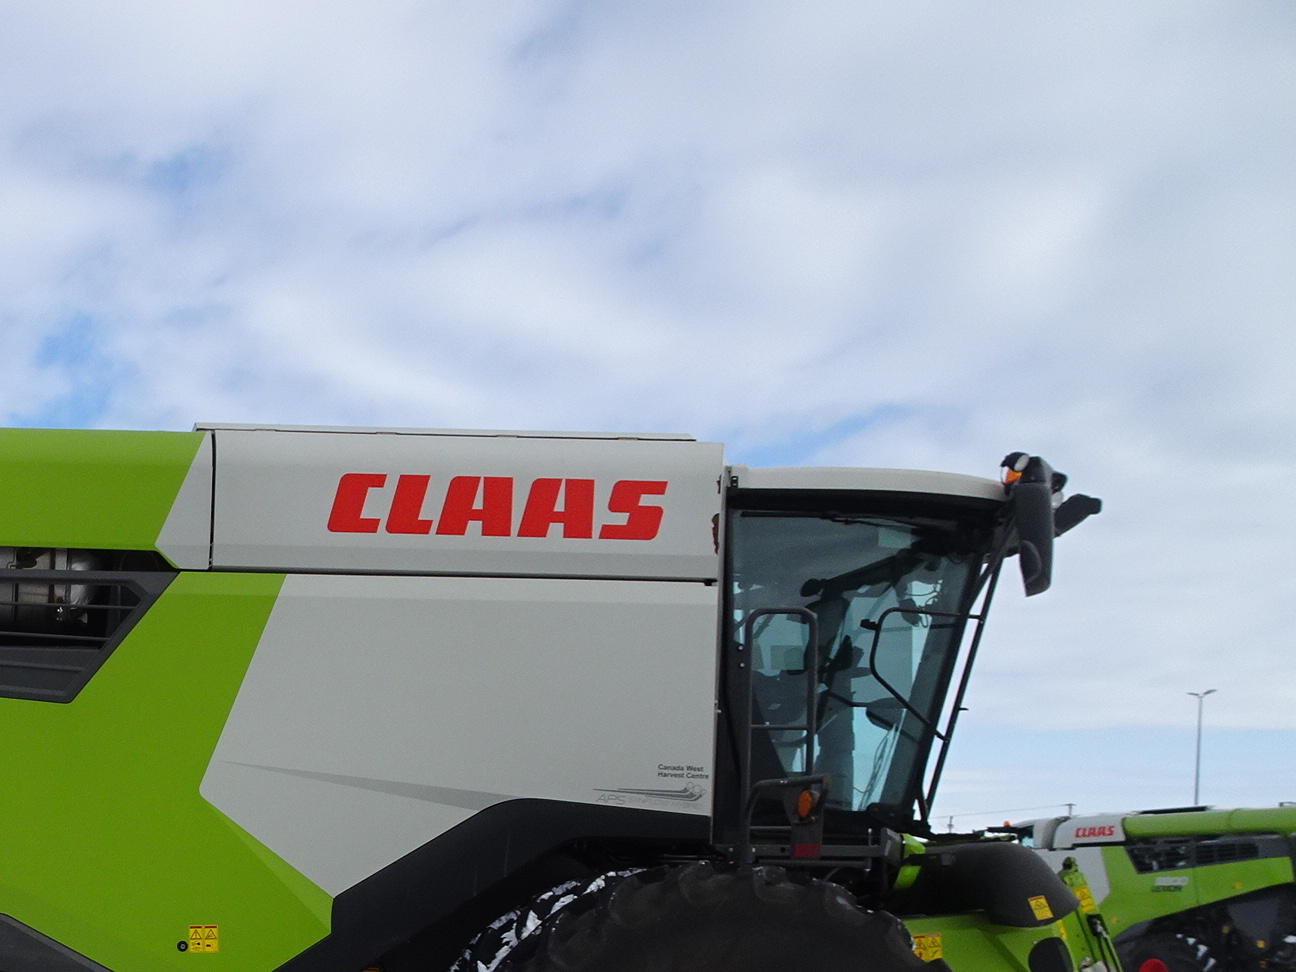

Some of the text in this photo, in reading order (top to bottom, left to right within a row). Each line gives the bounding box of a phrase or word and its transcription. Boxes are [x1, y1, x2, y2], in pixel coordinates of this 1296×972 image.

[327, 473, 668, 540] CLAAS
[657, 764, 684, 772] Canada
[1075, 825, 1115, 838] CLAAS
